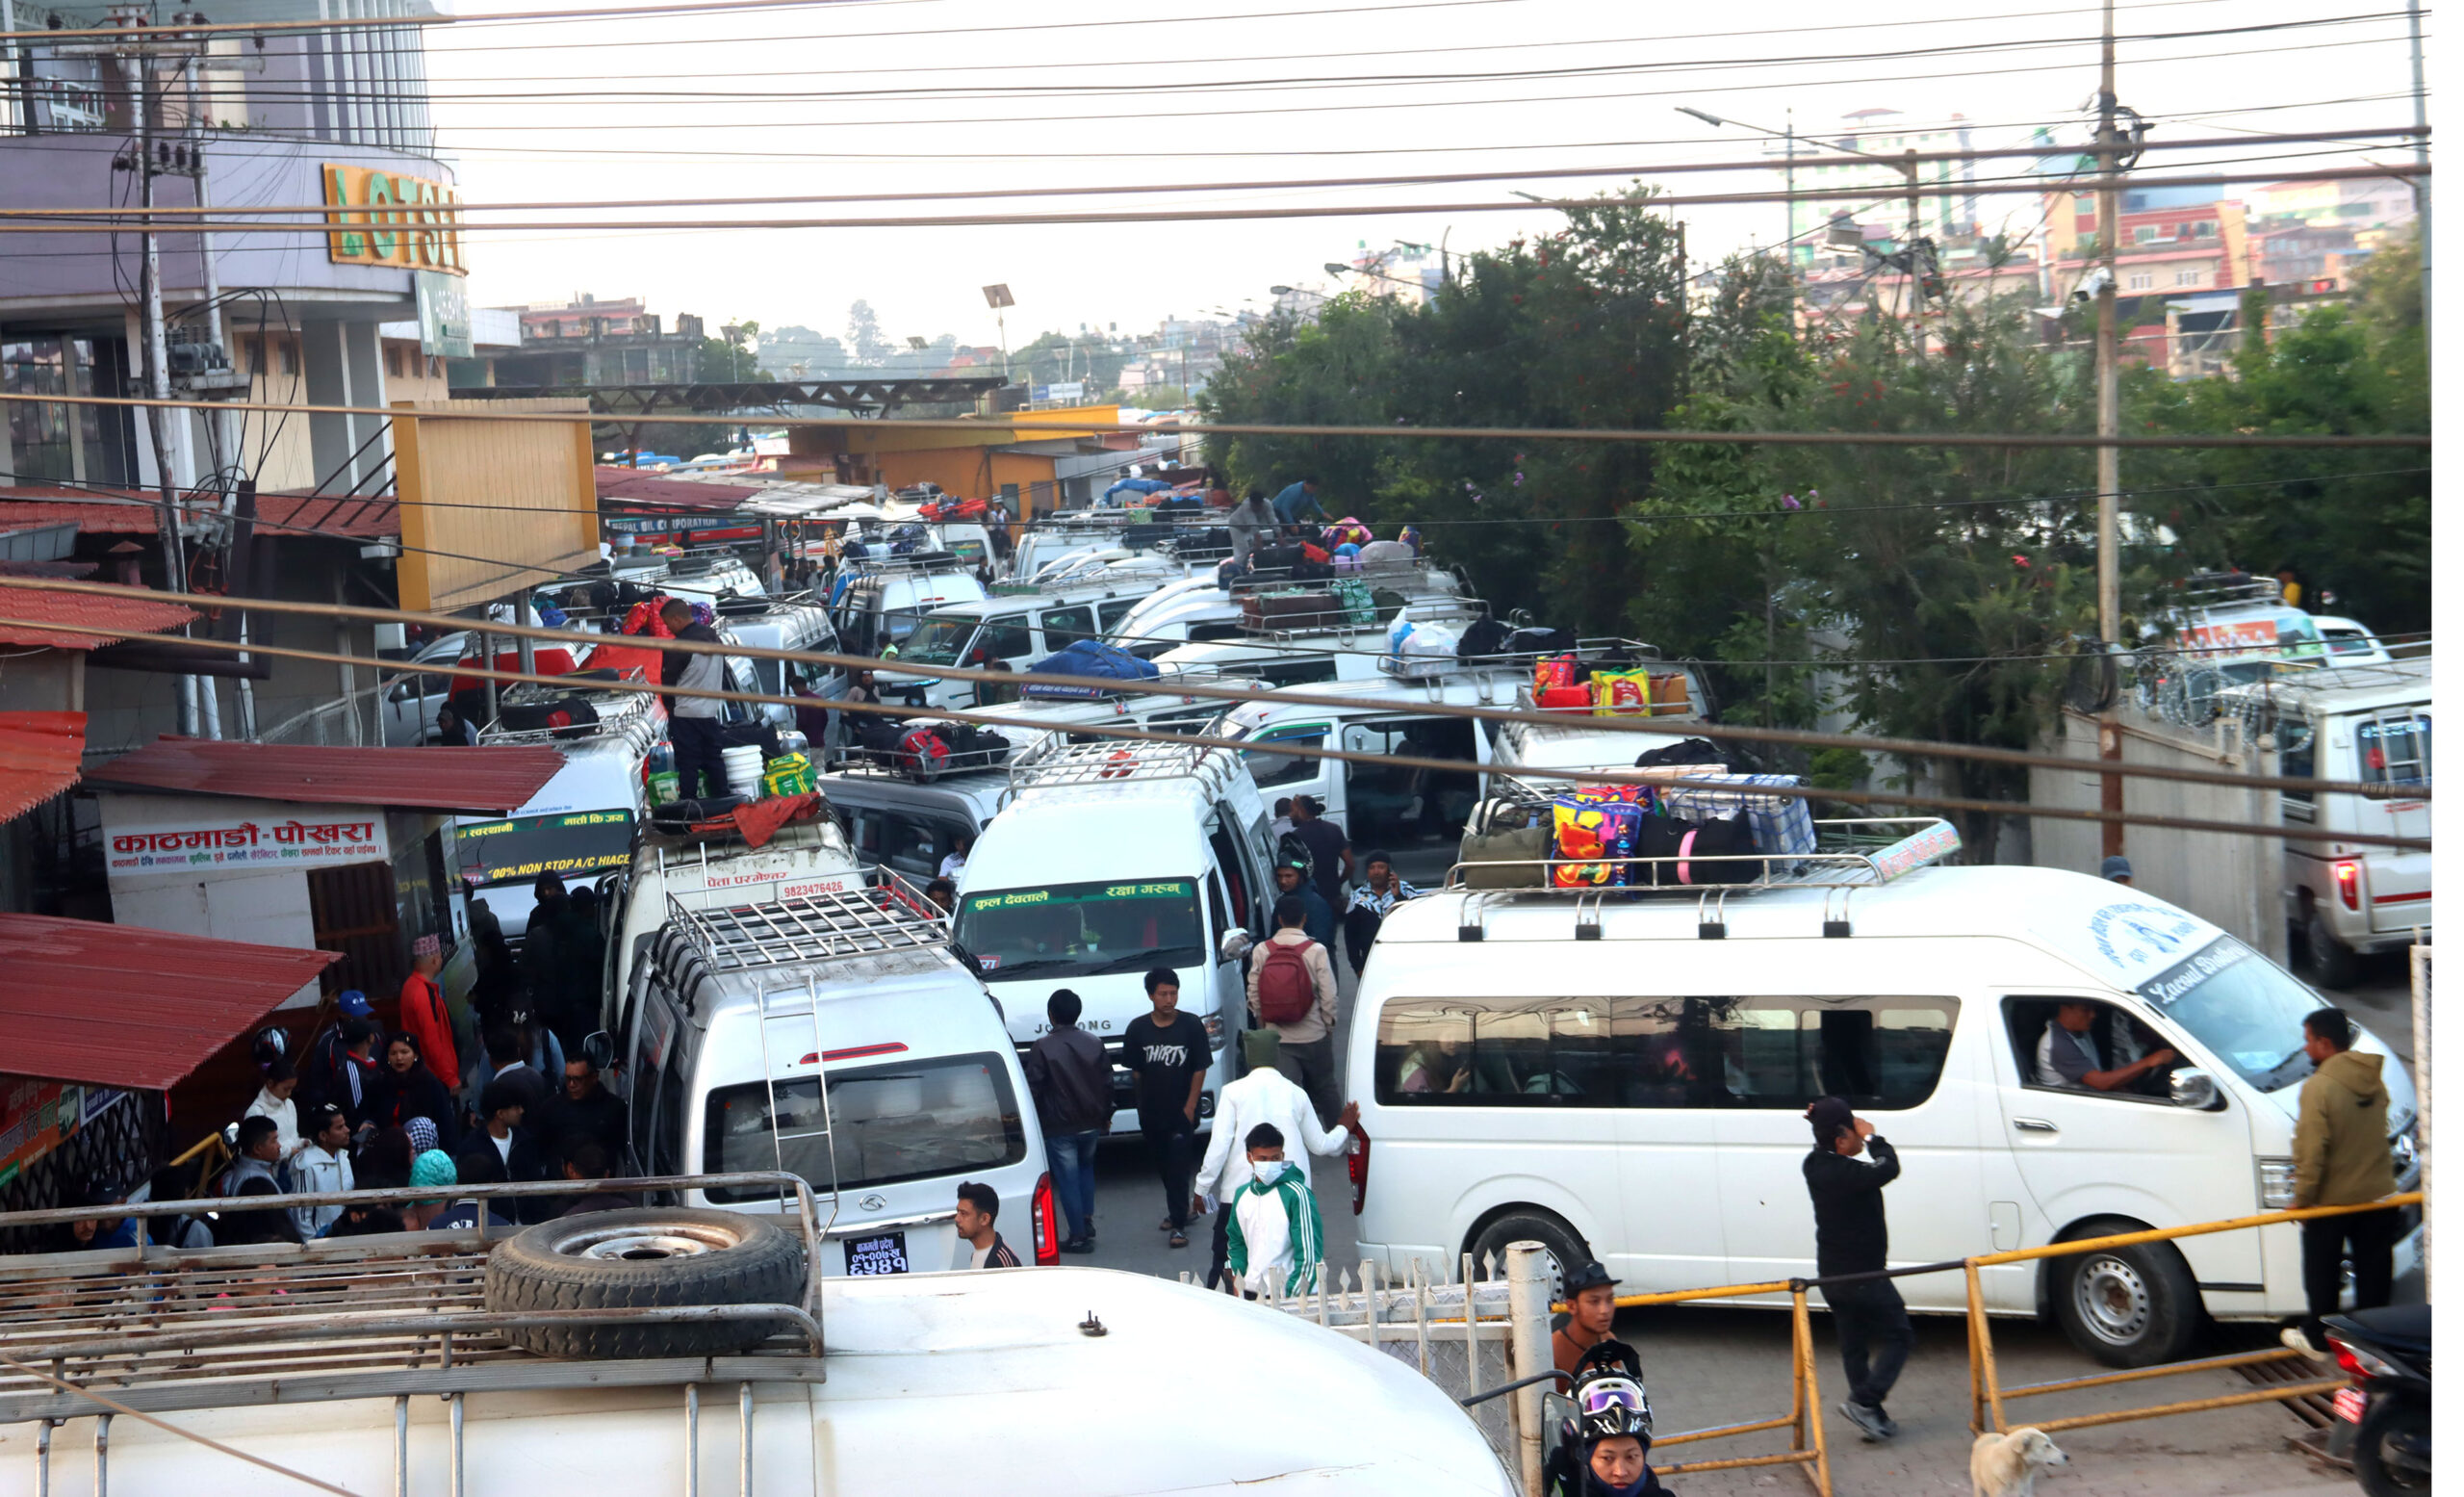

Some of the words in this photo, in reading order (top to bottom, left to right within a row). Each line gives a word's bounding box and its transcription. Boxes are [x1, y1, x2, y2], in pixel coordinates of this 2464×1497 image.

[641, 521, 655, 531] OIL
[657, 517, 718, 529] CPORATION
[518, 862, 543, 876] NON
[544, 858, 575, 872] STOP
[575, 856, 596, 868] A/C
[598, 853, 631, 866] HIACE
[784, 881, 844, 897] 9823476426
[1105, 884, 1136, 897] रक्षा
[1034, 1020, 1112, 1034] JOONG
